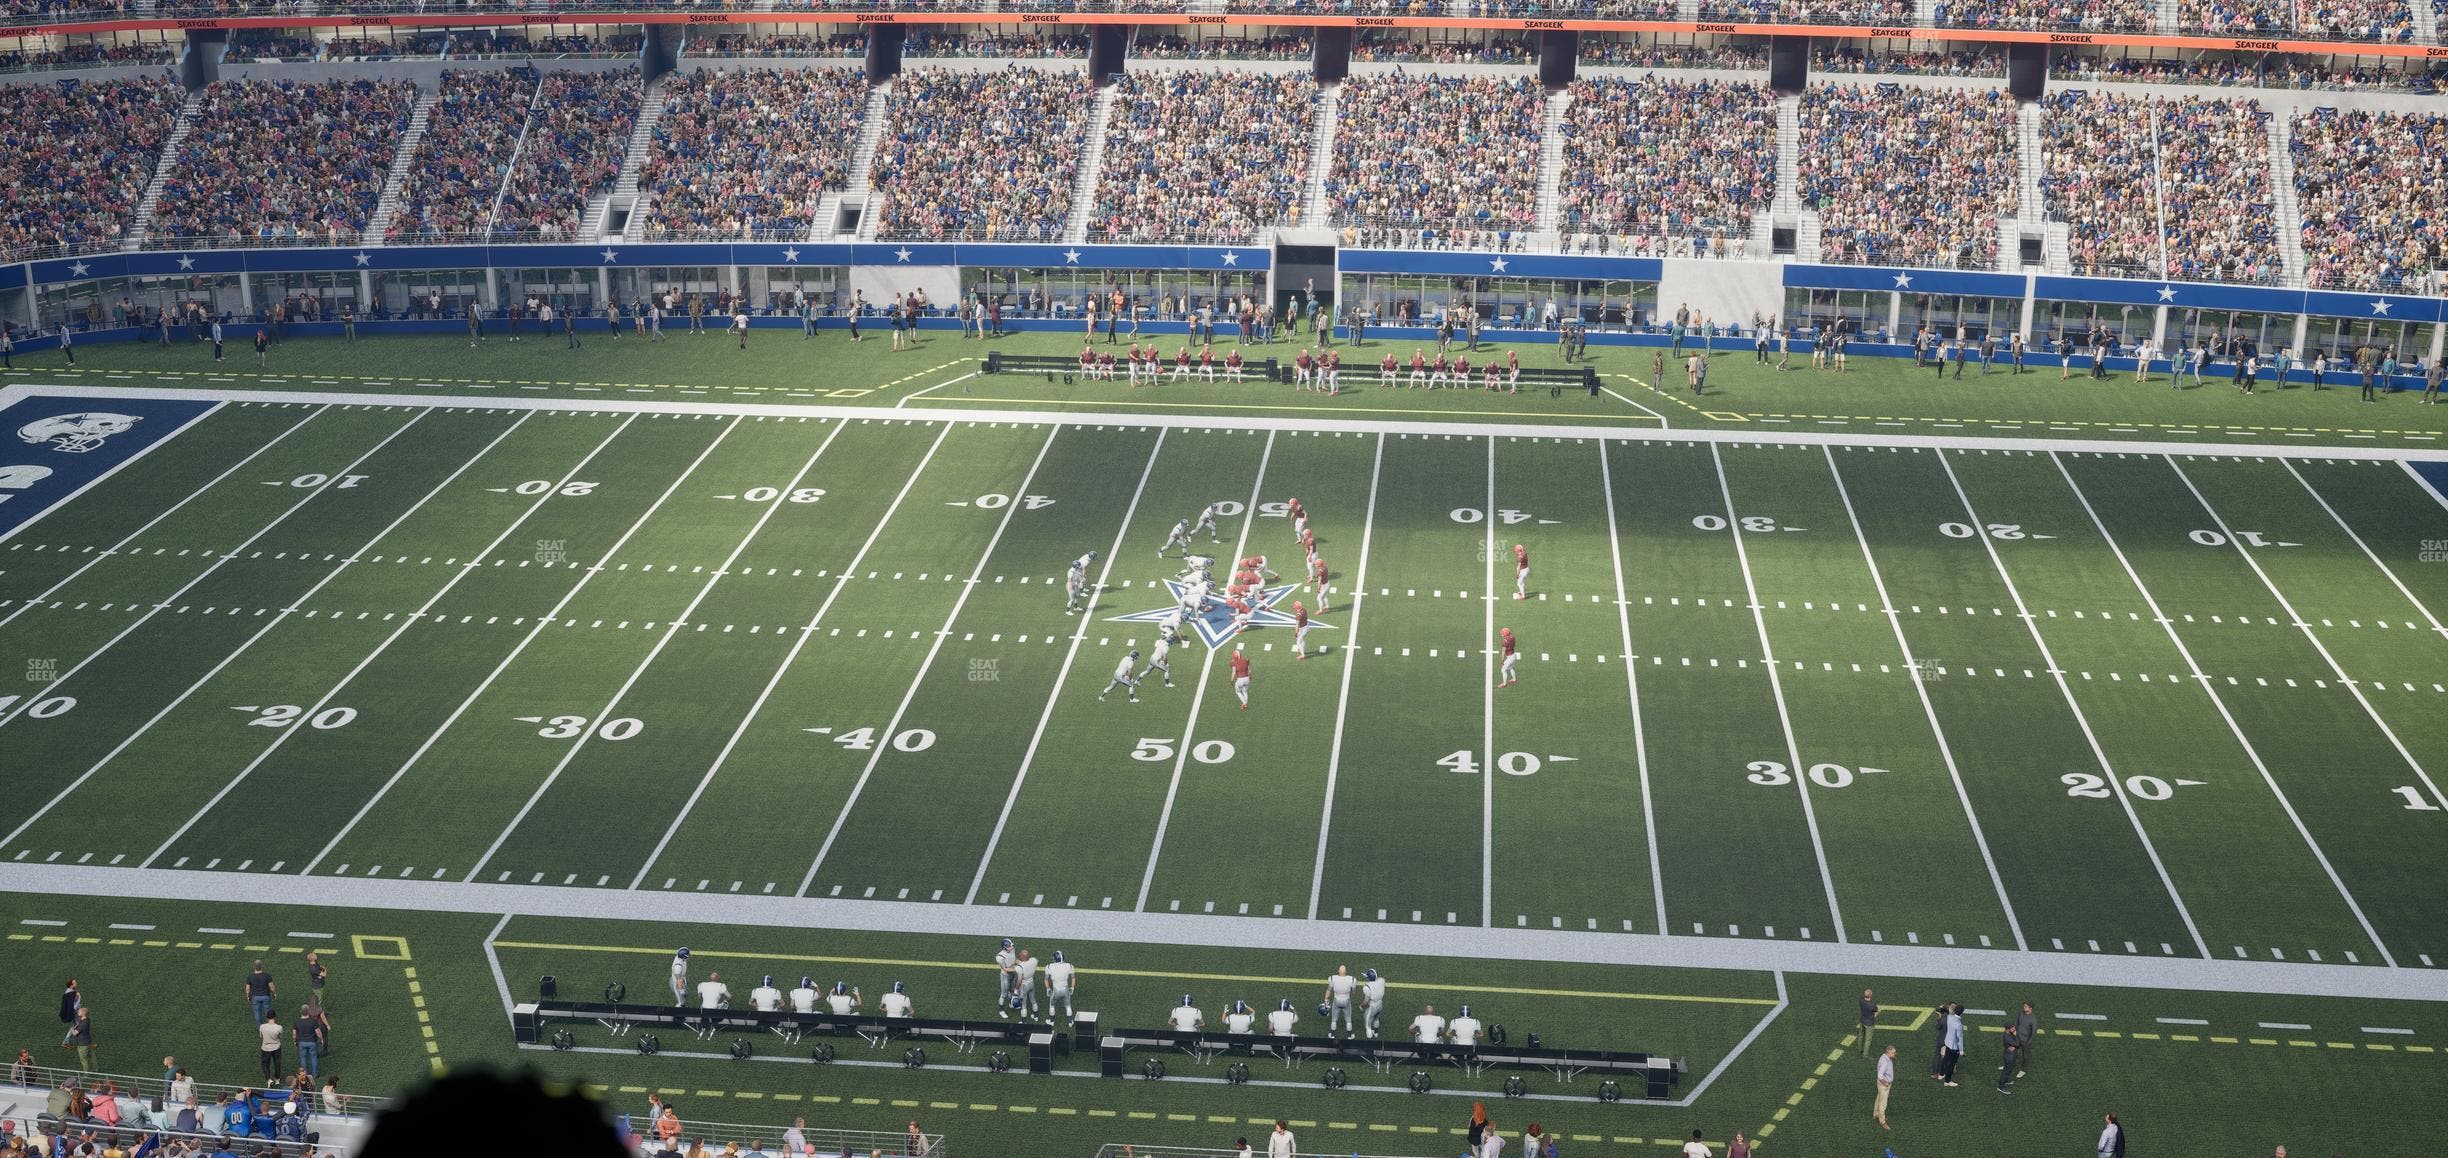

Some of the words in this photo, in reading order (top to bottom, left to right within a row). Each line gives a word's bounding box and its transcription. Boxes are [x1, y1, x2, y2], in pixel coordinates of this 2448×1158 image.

[351, 17, 390, 25] SEATGEEK
[521, 15, 560, 23] SEATGEEK
[689, 14, 728, 22] SEATGEEK
[857, 14, 895, 22] SEATGEEK
[1022, 14, 1061, 22] SEATGEEK
[1189, 15, 1227, 24] SEATGEEK
[1356, 18, 1394, 26] SEATGEEK
[177, 20, 216, 28] SEATGEEK
[1524, 20, 1563, 29] SEATGEEK
[1696, 24, 1735, 33] SEATGEEK
[0, 27, 36, 37] EATGEEK
[1872, 29, 1912, 38] SEATGEEK
[2051, 34, 2093, 43] SEATGEEK
[2236, 41, 2279, 50] SEATGEEK
[248, 704, 358, 730] 20
[538, 715, 644, 741] 30
[833, 727, 937, 753] 40
[1130, 737, 1235, 764] 50
[1436, 749, 1541, 776] 40
[1746, 760, 1854, 789] 30
[2060, 772, 2173, 802] 20
[231, 1112, 243, 1125] 00
